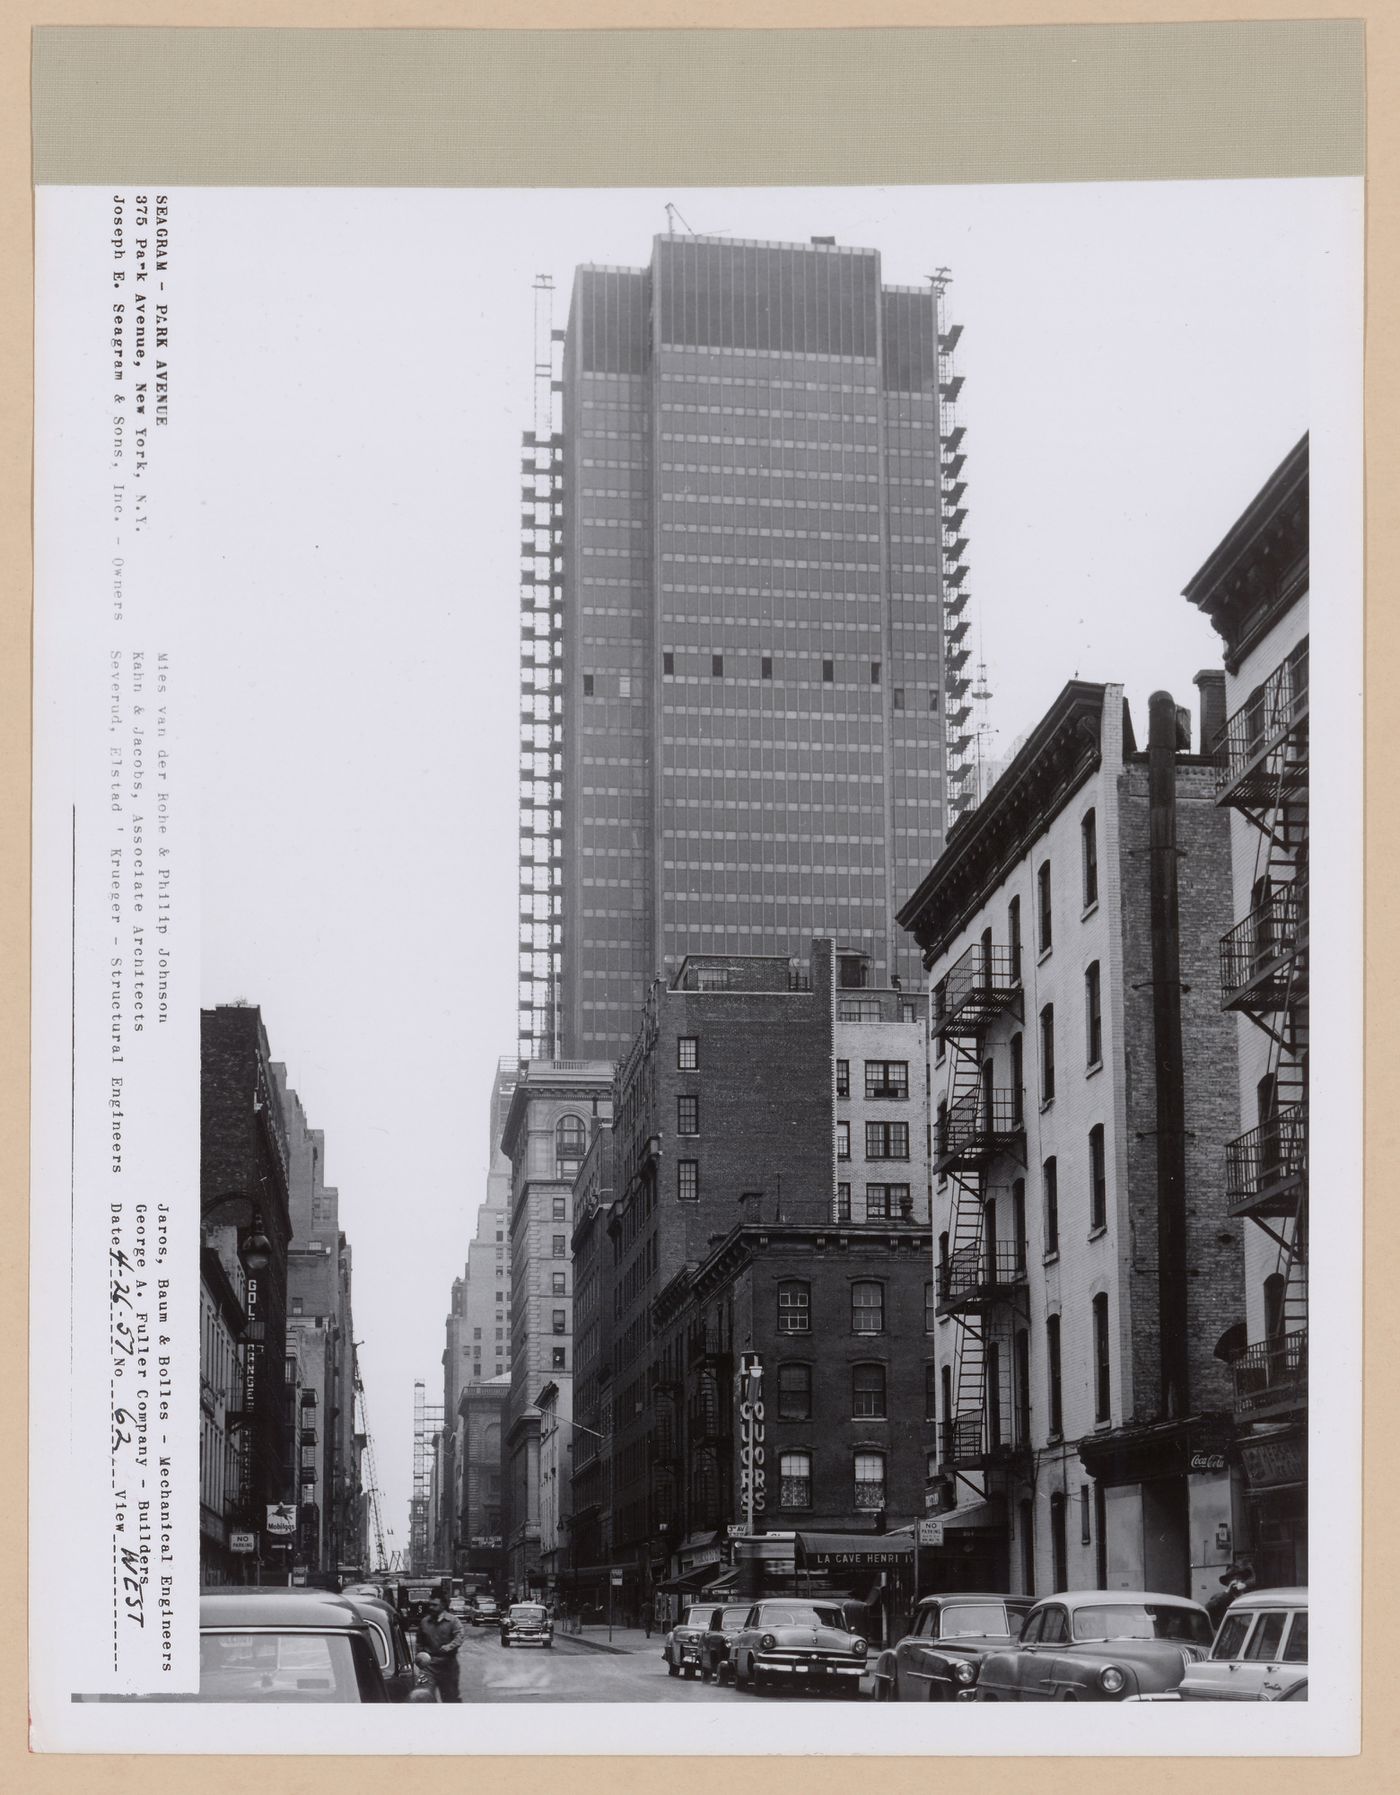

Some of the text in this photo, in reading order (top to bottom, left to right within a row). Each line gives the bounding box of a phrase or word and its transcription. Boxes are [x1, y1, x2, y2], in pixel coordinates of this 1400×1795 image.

[268, 1523, 295, 1531] Mobilgas
[817, 1555, 830, 1563] LA
[835, 1554, 861, 1563] CAVE
[867, 1554, 898, 1563] HENRI
